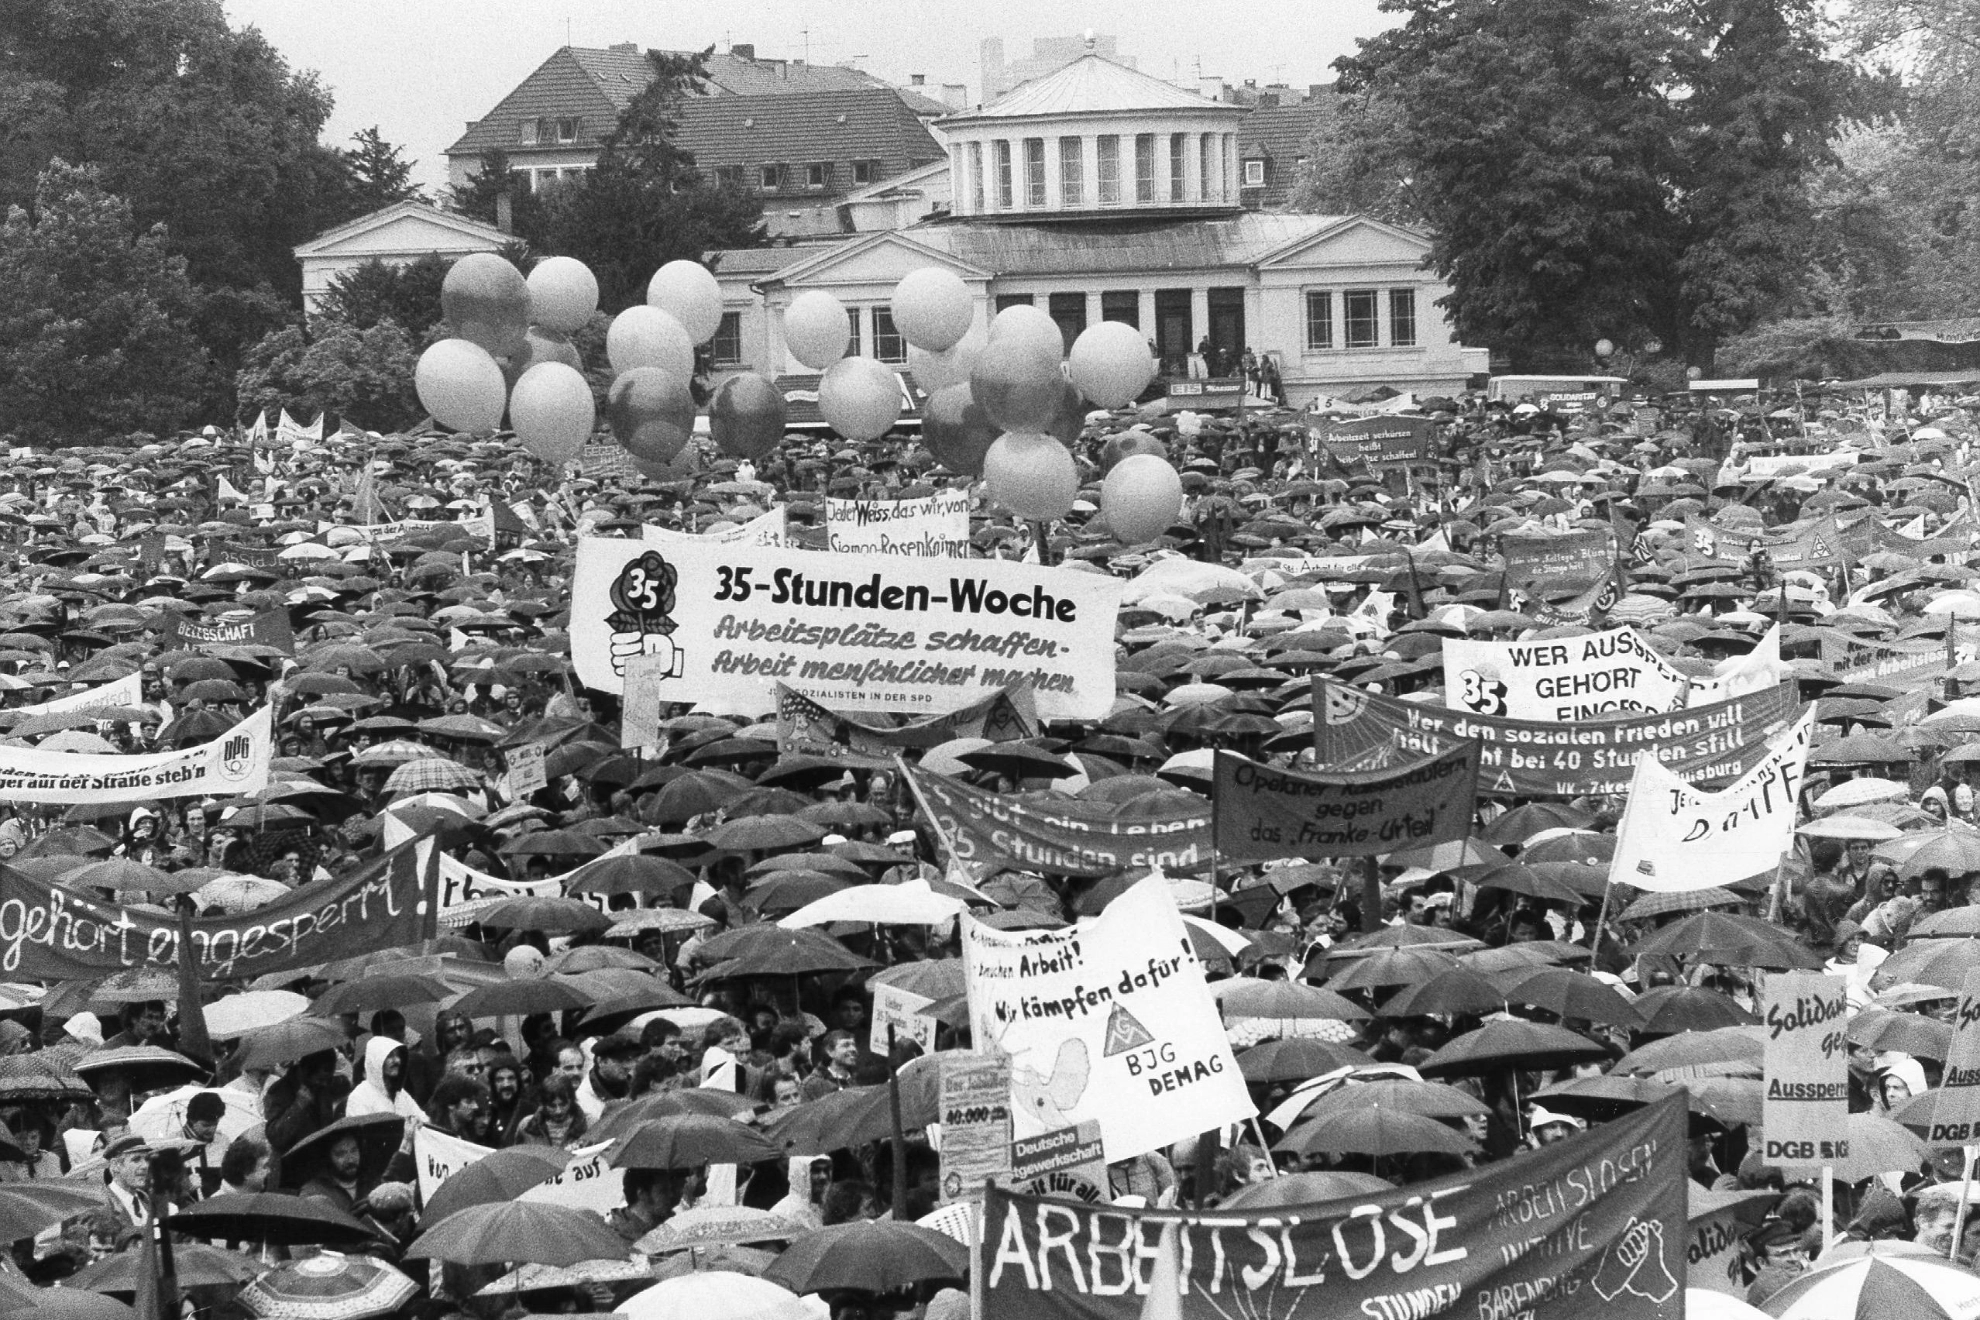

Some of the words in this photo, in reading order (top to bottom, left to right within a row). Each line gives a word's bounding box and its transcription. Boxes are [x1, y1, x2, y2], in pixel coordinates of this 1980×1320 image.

[627, 567, 660, 610] 35
[712, 564, 1077, 623] 35-Stunden-Woche
[177, 621, 256, 642] BELEGSCHAFT
[713, 614, 917, 650] Arbeitsplätze
[711, 649, 798, 677] Arbeit
[1507, 644, 1569, 668] WER
[884, 693, 907, 702] DER
[910, 694, 933, 703] SPD
[1459, 669, 1509, 717] 35
[1535, 667, 1642, 699] GEHÖRT
[1406, 708, 1444, 732] Wer
[1453, 719, 1496, 741] den
[1504, 722, 1605, 746] sozialen
[1614, 714, 1701, 744] Frieden
[1510, 748, 1546, 770] bei
[1553, 750, 1582, 770] 40
[1694, 728, 1745, 757] still
[1315, 799, 1384, 820] gegen
[1250, 817, 1282, 844] das
[991, 829, 1117, 870] Stunden
[1131, 843, 1198, 868] sind
[0, 888, 137, 972] gehört
[147, 834, 436, 978] eingesperrt!
[1019, 940, 1084, 979] Arbeit!
[995, 1000, 1017, 1023] Wir
[1021, 985, 1113, 1020] kämpfen
[1117, 937, 1195, 995] dafür!
[1148, 1054, 1223, 1097] DEMAG
[1015, 1131, 1076, 1158] Deutsche
[1766, 1140, 1815, 1159] DGB
[1932, 1123, 1971, 1141] DGB
[572, 1155, 602, 1182] auf
[1049, 1173, 1077, 1193] für
[988, 1184, 1469, 1296] ARBEITSLOSE
[1360, 1281, 1462, 1320] STUNDEN
